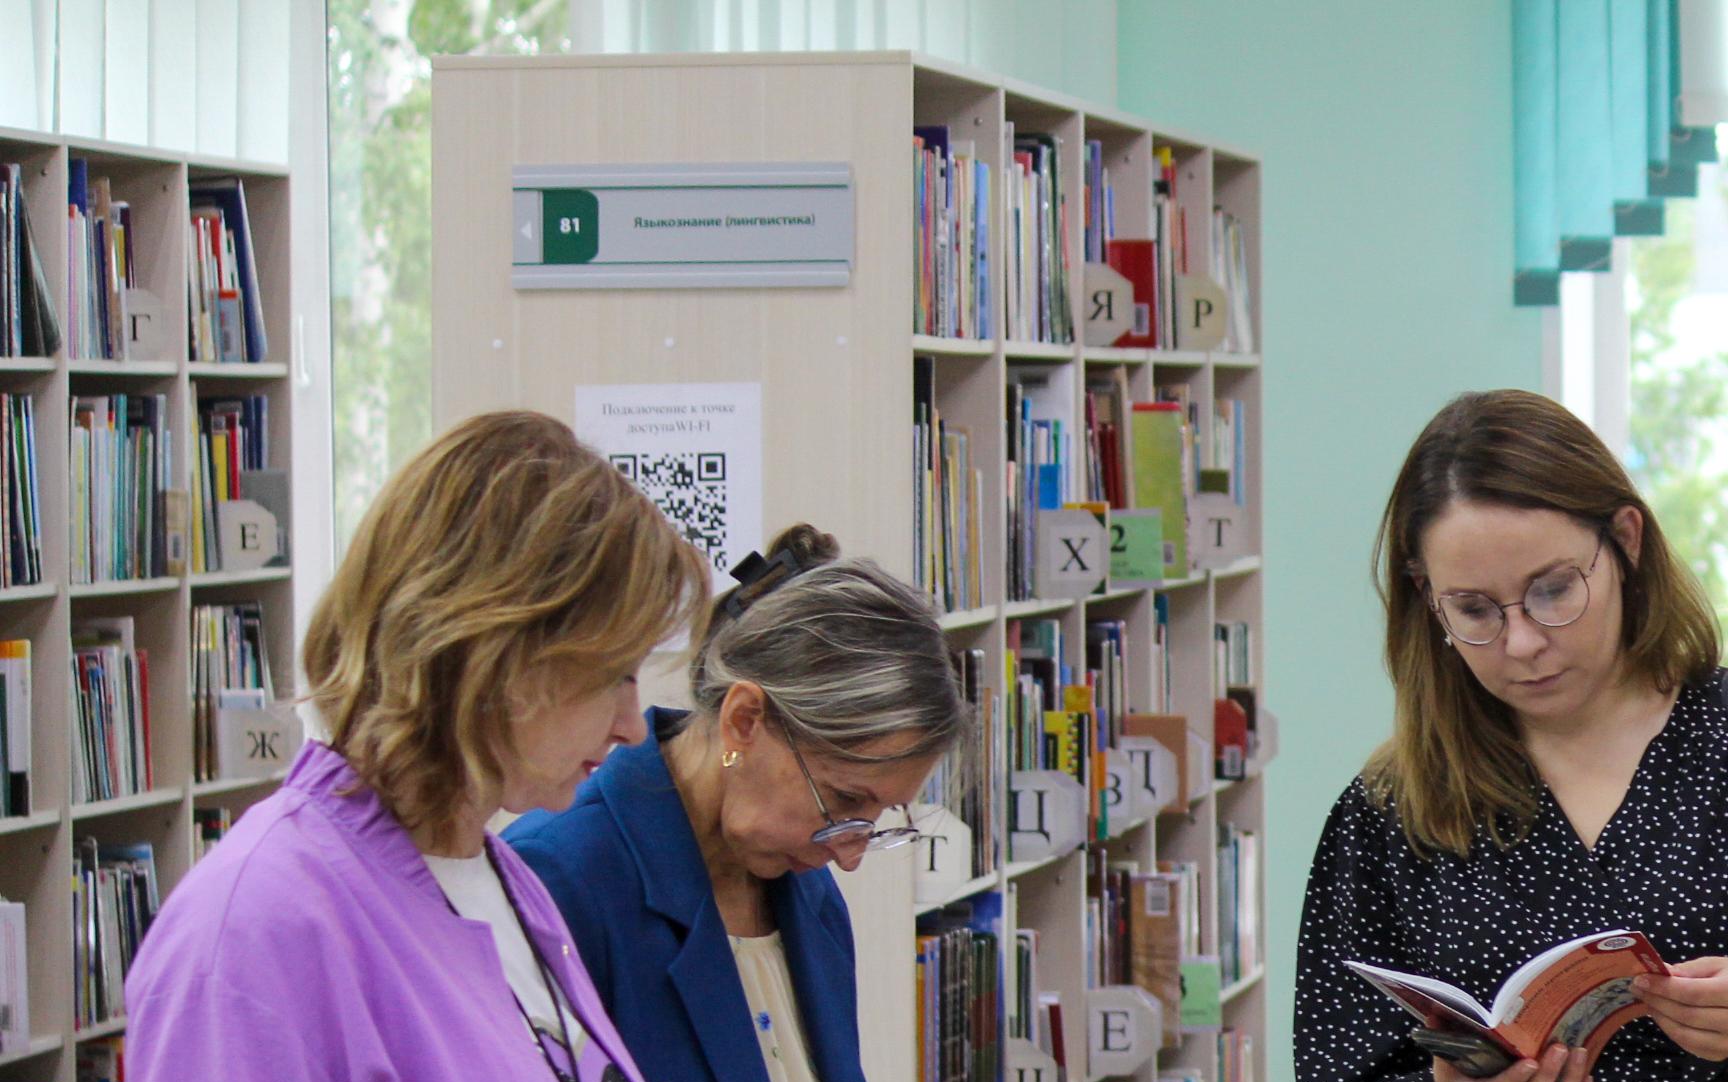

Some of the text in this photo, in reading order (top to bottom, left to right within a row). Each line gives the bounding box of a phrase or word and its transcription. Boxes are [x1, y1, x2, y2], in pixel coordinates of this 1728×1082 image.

[559, 217, 580, 233] 81
[633, 213, 816, 229] Языкознание (лингвистика)
[1088, 291, 1113, 321] Я
[1193, 298, 1214, 328] Р
[129, 312, 151, 342] Г
[602, 402, 736, 418] Подключение к точке
[240, 523, 261, 551] Е
[1208, 517, 1231, 548] Т
[1061, 537, 1090, 572] Х
[247, 731, 279, 759] Ж
[918, 836, 947, 872] Т
[1098, 1010, 1132, 1053] Е
